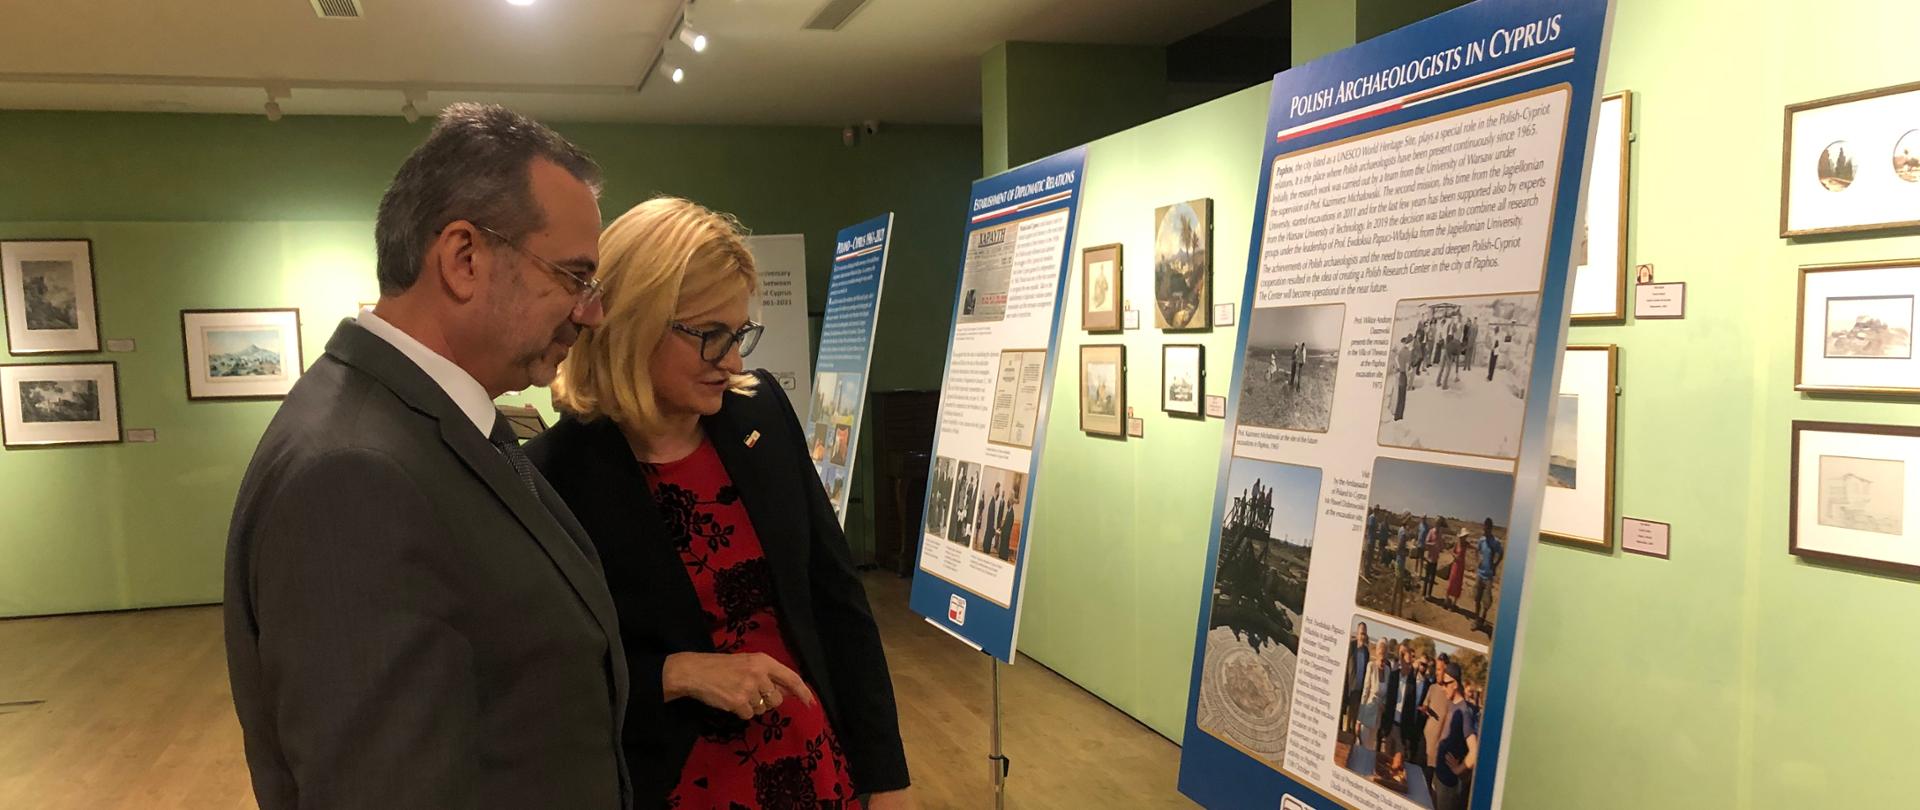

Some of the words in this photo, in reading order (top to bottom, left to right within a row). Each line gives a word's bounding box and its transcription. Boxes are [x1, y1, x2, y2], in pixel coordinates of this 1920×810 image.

[1290, 88, 1332, 118] POLISH
[1335, 46, 1462, 105] ARCHAEOLOGISTS
[1465, 38, 1486, 66] IN
[1488, 14, 1562, 58] CYPRUS
[1336, 147, 1361, 161] UNESCO
[1440, 123, 1462, 141] special
[1463, 120, 1476, 133] role
[1485, 115, 1497, 128] the
[1499, 101, 1551, 125] Polish-Cypriot
[1396, 152, 1411, 163] have
[1412, 149, 1427, 160] been
[1427, 141, 1452, 160] present
[1453, 133, 1494, 151] continuously
[1496, 130, 1515, 142] since
[1414, 164, 1425, 175] the
[1425, 157, 1457, 173] University
[1466, 152, 1493, 165] Warsaw
[1494, 146, 1516, 159] under
[1442, 174, 1454, 185] this
[1454, 172, 1470, 183] time
[1471, 169, 1488, 180] from
[1488, 165, 1501, 177] the
[973, 191, 1008, 211] ESTABLISHMENT
[1007, 189, 1015, 201] OF
[1014, 179, 1045, 199] DIPLOMATIC
[1045, 170, 1075, 190] RELATIONS
[1427, 194, 1438, 204] has
[1439, 192, 1456, 202] been
[1456, 184, 1491, 202] supported
[1492, 182, 1507, 194] also
[1518, 175, 1546, 193] experts
[1425, 211, 1437, 221] was
[1438, 207, 1456, 219] taken
[1465, 201, 1496, 215] combine
[1497, 198, 1506, 211] all
[1507, 193, 1539, 209] research
[1435, 224, 1446, 235] the
[1380, 249, 1396, 260] need
[1403, 246, 1430, 258] continue
[1431, 243, 1444, 255] and
[1445, 243, 1470, 256] deepen
[1471, 235, 1521, 252] Polish-Cypriot
[1365, 266, 1382, 277] Polish
[1382, 263, 1408, 276] Research
[1409, 262, 1430, 273] Center
[1438, 260, 1449, 271] the
[1450, 259, 1463, 273] city
[769, 289, 792, 297] Cyprus
